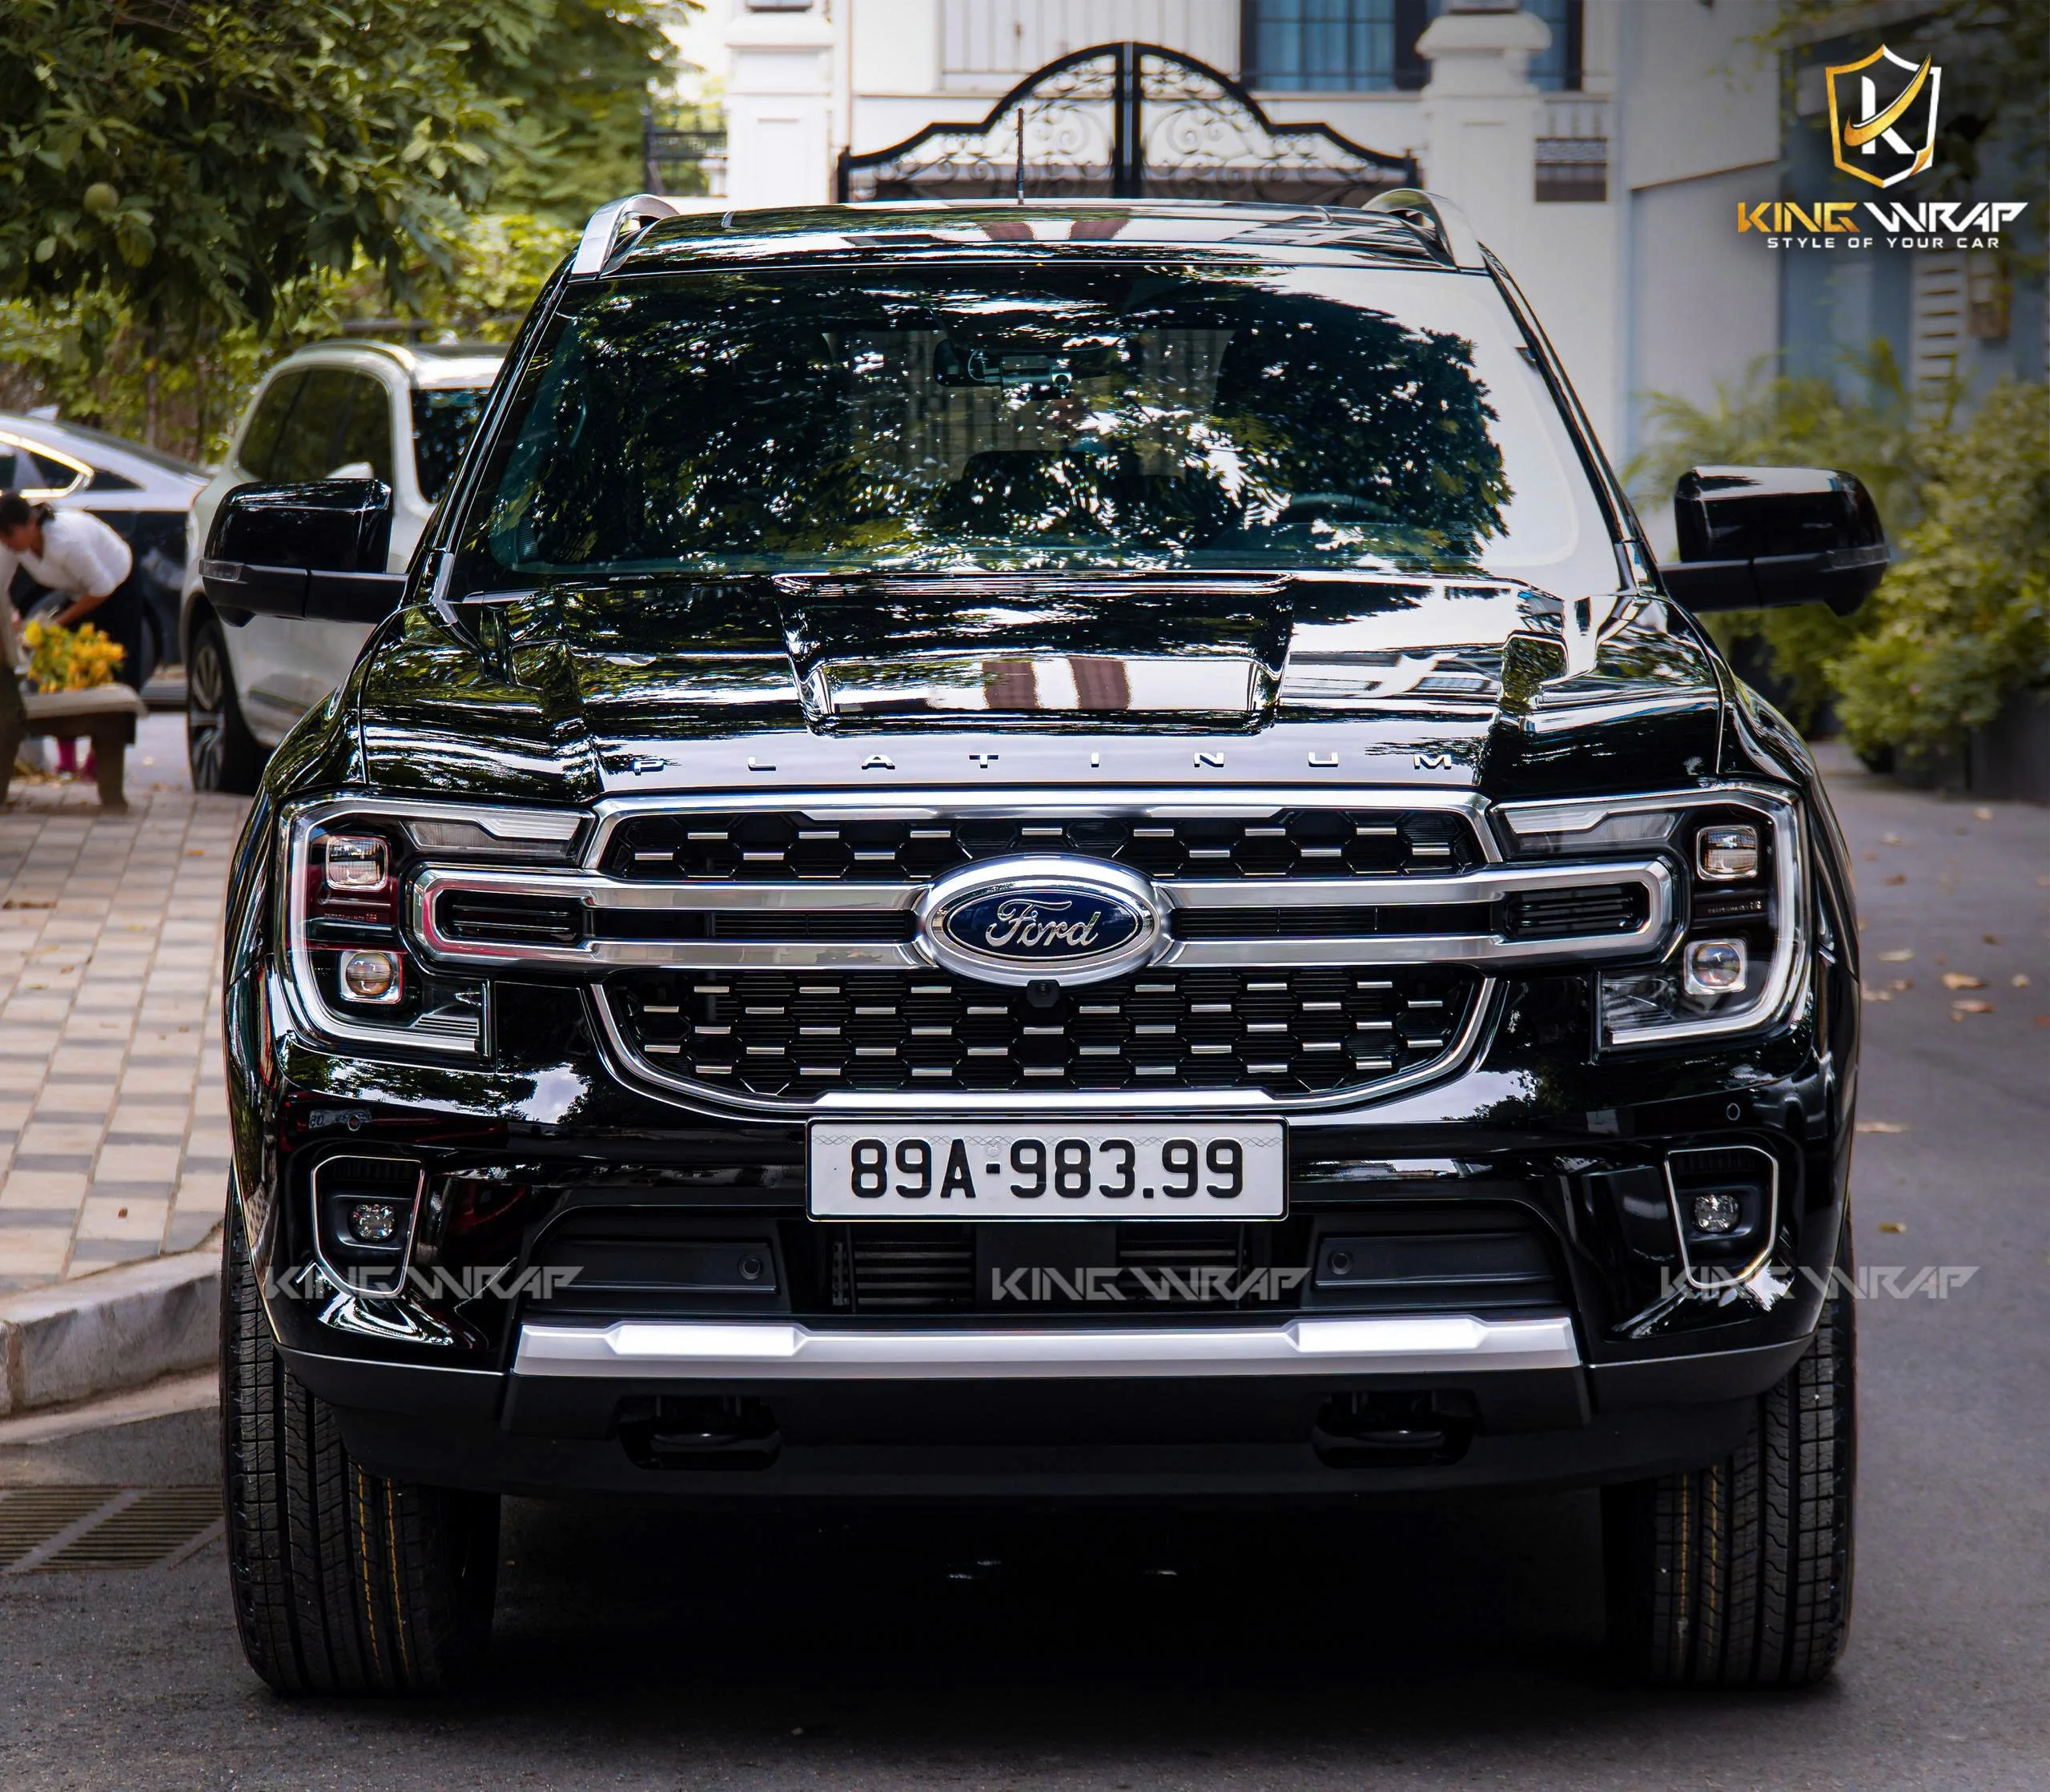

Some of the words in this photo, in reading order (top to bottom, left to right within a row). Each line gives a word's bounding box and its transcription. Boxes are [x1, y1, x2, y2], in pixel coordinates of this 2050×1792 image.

[633, 752, 1452, 776] PLATINUM
[985, 898, 1101, 946] Ford
[851, 1138, 1244, 1199] 89A-983.99
